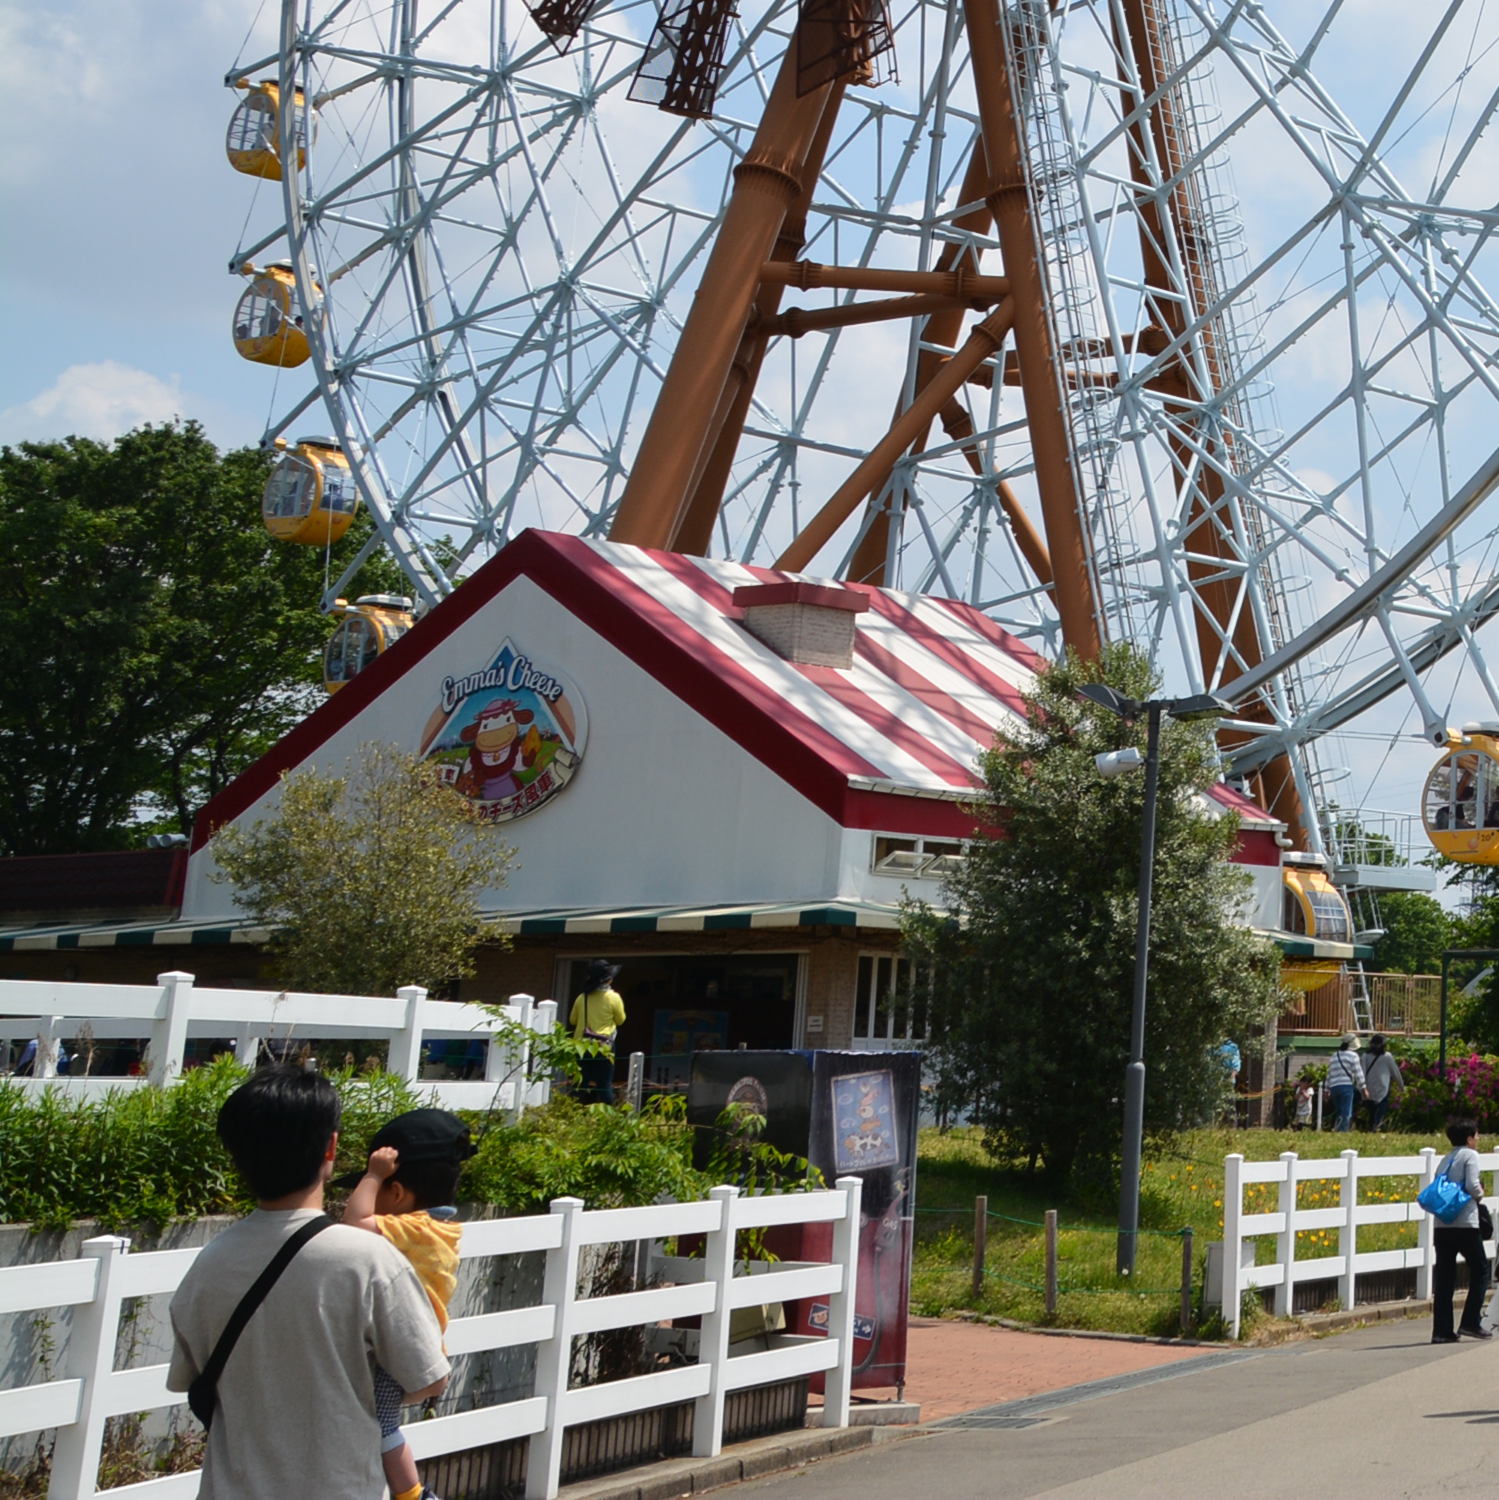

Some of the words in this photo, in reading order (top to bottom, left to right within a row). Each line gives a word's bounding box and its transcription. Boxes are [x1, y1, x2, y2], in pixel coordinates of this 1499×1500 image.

[443, 661, 504, 714] Emma's
[507, 655, 562, 701] Cheese
[882, 1218, 898, 1231] GAS
